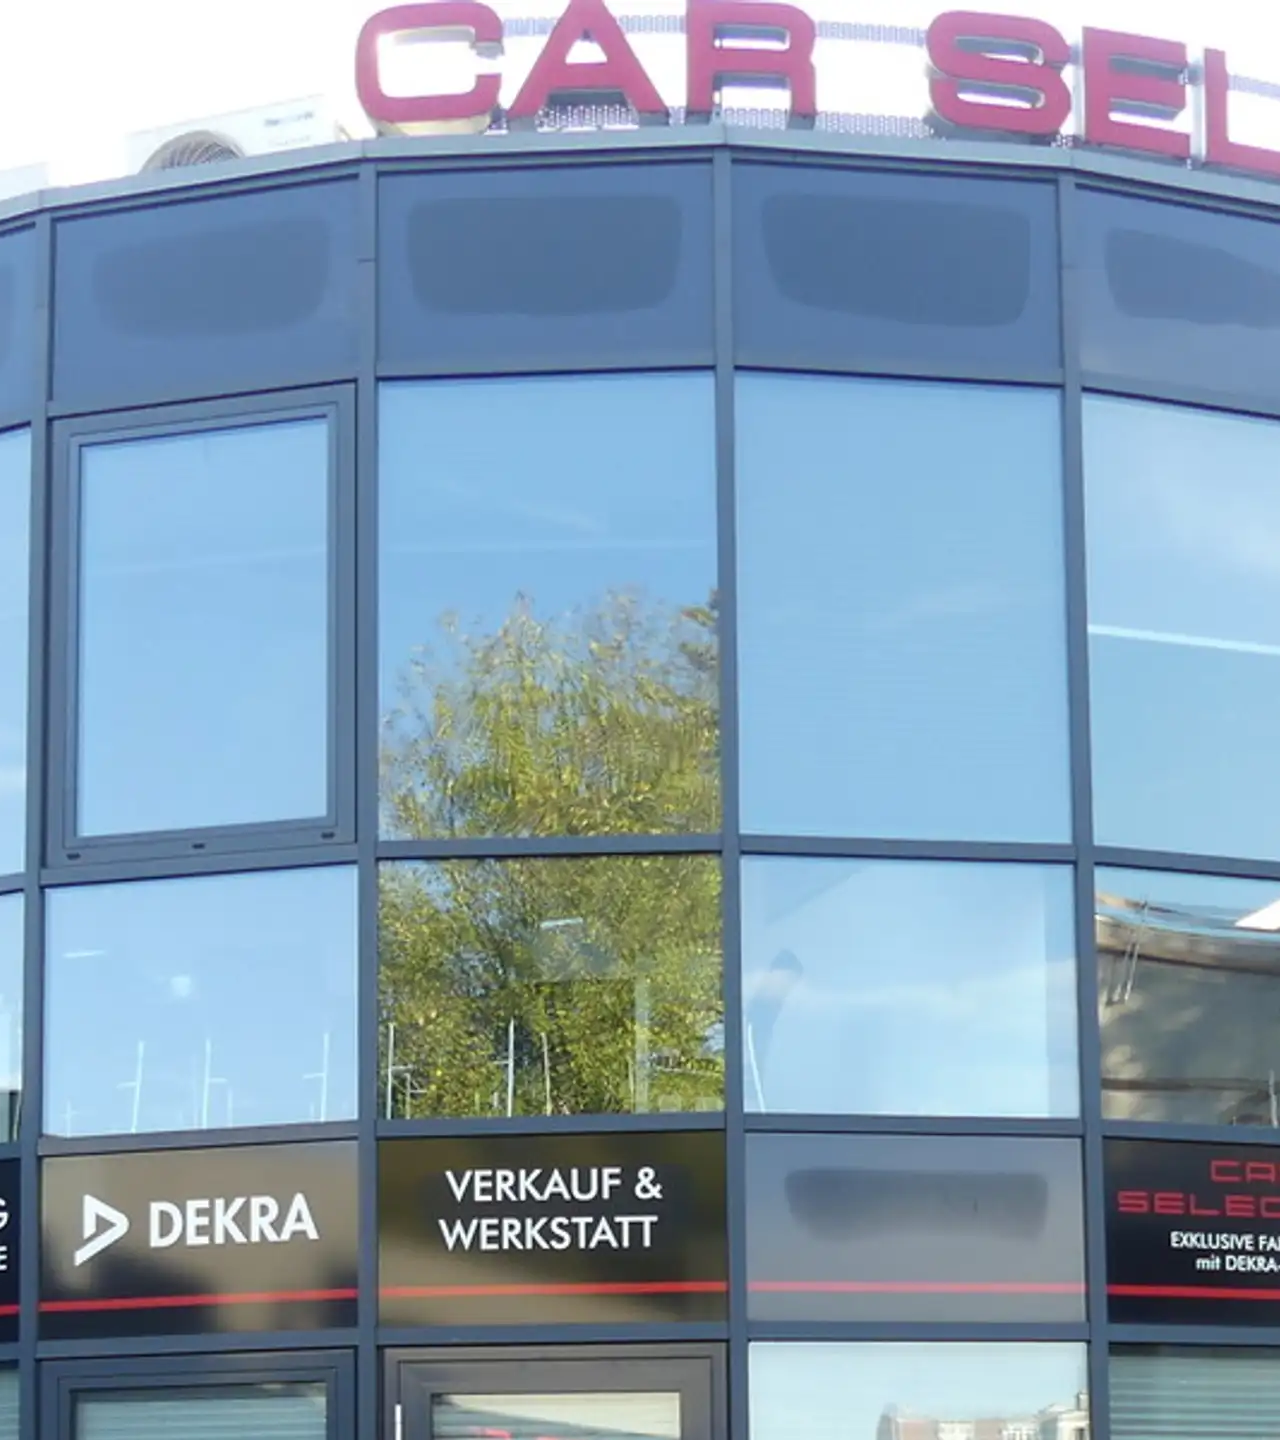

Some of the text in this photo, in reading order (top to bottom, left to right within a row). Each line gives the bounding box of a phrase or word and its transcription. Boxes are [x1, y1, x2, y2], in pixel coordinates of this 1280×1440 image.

[356, 0, 816, 122] CAR
[445, 1165, 664, 1202] VERKAUF &
[148, 1192, 320, 1249] DEKRA
[438, 1214, 659, 1252] WERKSTATT
[1170, 1231, 1255, 1251] EXKLUSIVE
[1195, 1254, 1221, 1271] mit
